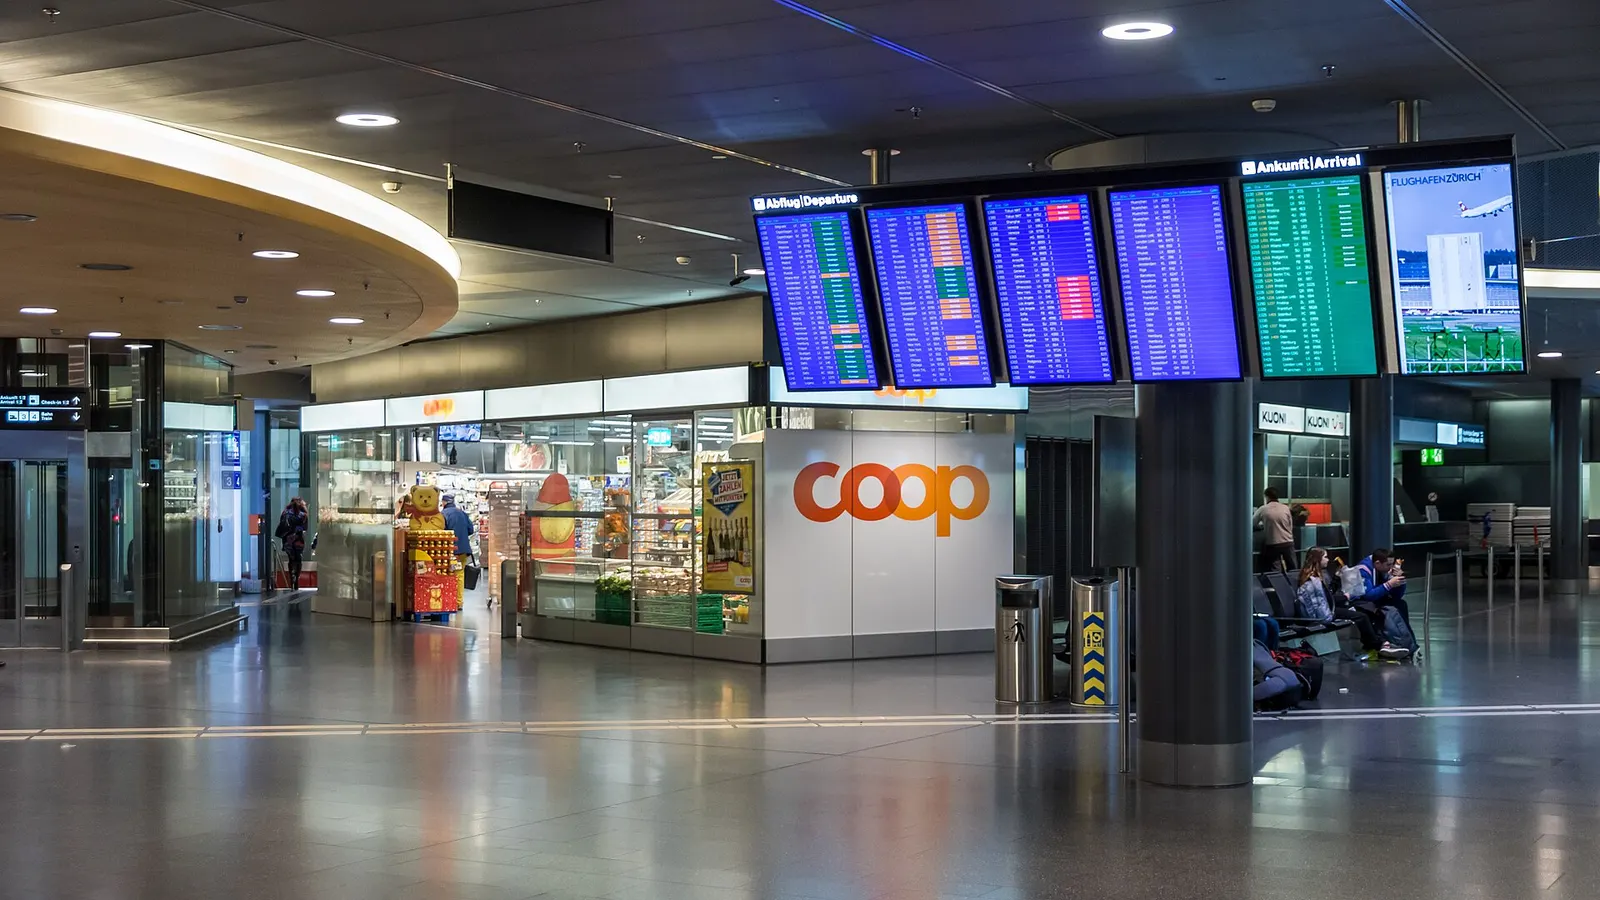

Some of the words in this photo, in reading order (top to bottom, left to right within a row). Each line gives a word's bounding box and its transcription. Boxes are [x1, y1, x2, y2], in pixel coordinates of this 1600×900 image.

[1262, 410, 1287, 424] KUONI
[1307, 416, 1329, 428] KUONI
[719, 481, 741, 493] ZAHLEN
[793, 460, 990, 538] coop
